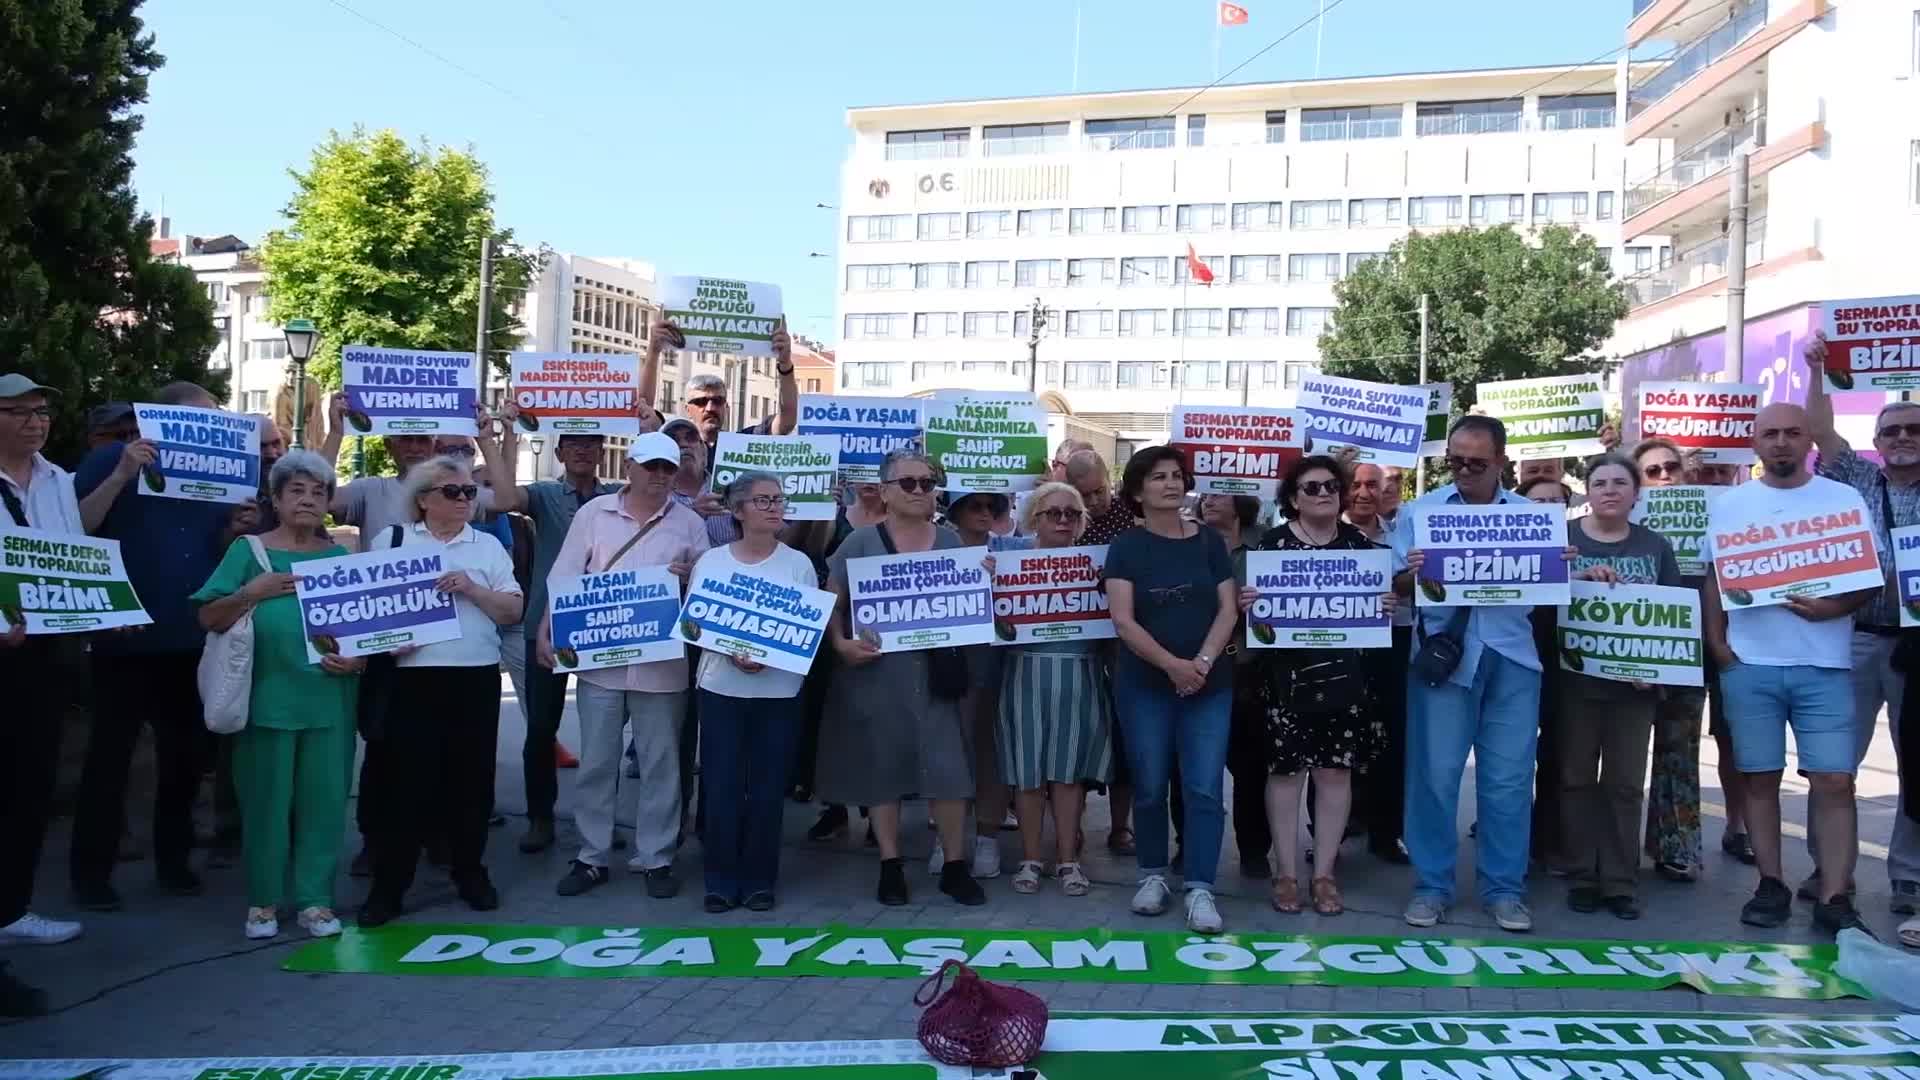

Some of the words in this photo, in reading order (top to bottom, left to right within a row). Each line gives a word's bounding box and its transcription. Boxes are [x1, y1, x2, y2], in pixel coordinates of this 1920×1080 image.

[696, 287, 748, 300] MADEN
[1834, 304, 1912, 321] SERMAYE
[1836, 322, 1859, 336] BU
[1862, 318, 1920, 333] TOPRA
[346, 352, 414, 366] ORMANIMI
[416, 356, 470, 368] SUYUMU
[1849, 338, 1920, 370] BİZİ
[363, 366, 458, 386] MADENE
[543, 359, 608, 372] ESKİŞEHİR
[520, 372, 568, 382] MADEN
[571, 371, 631, 384] ÇÖPLÜĞÜ
[359, 392, 459, 410] VERMEM!
[518, 389, 632, 410] OLMASIN!
[1303, 381, 1362, 399] HAVAMA
[1366, 390, 1424, 408] SUYUMA
[1482, 387, 1539, 402] HAVAMA
[1542, 382, 1599, 397] SUYUMA
[1645, 388, 1689, 406] DOĞA
[1693, 393, 1758, 411] YAŞAM
[955, 405, 1008, 420] YAŞAM
[1321, 396, 1403, 417] TOPRAĞIMA
[1503, 395, 1580, 411] TOPRAĞIMA
[140, 409, 208, 424] ORMANIMI
[211, 415, 256, 432] SUYUMU
[803, 402, 851, 421] DOĞA
[855, 408, 917, 427] YAŞAM
[1183, 413, 1249, 427] SERMAYE
[1251, 415, 1294, 428] DEFOL
[928, 417, 1037, 434] ALANLARIMIZA
[1184, 426, 1204, 439] BU
[1207, 427, 1292, 442] TOPRAKLAR
[160, 422, 247, 451] MADENE
[957, 437, 1004, 453] SAHİP
[747, 441, 812, 456] ESKİŞEHİR
[160, 449, 246, 478] VERMEM!
[723, 452, 770, 466] MADEN
[773, 453, 832, 469] ÇÖPLÜĞÜ
[940, 453, 1026, 470] ÇIKIYORUZ!
[1194, 446, 1279, 477] BİZİM!
[1649, 487, 1704, 500] ESKİŞEHİR
[1648, 500, 1706, 514] MADEN
[1428, 514, 1502, 529] SERMAYE
[1504, 513, 1553, 528] DEFOL
[1716, 522, 1777, 550] DOĞA
[1781, 509, 1862, 537] YAŞAM
[1430, 530, 1453, 543] BU
[1455, 528, 1552, 543] TOPRAKLAR
[4, 536, 68, 557] SERMAYE
[71, 545, 110, 561] DEFOL
[5, 553, 25, 567] BU
[29, 556, 111, 575] TOPRAKLAR
[881, 556, 956, 577] ESKİŞEHİR
[1020, 553, 1092, 572] ESKİŞEHİR
[1281, 556, 1358, 575] ESKİŞEHİR
[1443, 549, 1541, 582] BİZİM!
[1722, 539, 1864, 580] ÖZGÜRLÜK!
[303, 565, 363, 591] DOĞA
[367, 555, 442, 582] YAŞAM
[582, 571, 636, 591] YAŞAM
[858, 577, 912, 594] MADEN
[914, 568, 982, 592] ÇÖPLÜĞÜ
[996, 572, 1048, 586] MADEN
[1256, 574, 1311, 588] MADEN
[1313, 570, 1384, 590] ÇÖPLÜĞÜ
[18, 578, 113, 610] BİZİM!
[730, 572, 802, 600] ESKİŞEHİR
[308, 587, 450, 627] ÖZGÜRLÜK!
[555, 584, 669, 610] ALANLARIMIZA
[702, 578, 753, 602] MADEN
[752, 594, 823, 622] ÇÖPLÜĞÜ
[994, 590, 1109, 617] OLMASIN
[586, 605, 634, 627] SAHİP
[857, 592, 985, 624] OLMASIN!
[1252, 596, 1383, 620] OLMASIN!
[1568, 595, 1692, 629] KÖYÜME
[568, 621, 659, 650] ÇIKIYORUZ!
[688, 600, 816, 650] OLMASIN!
[1564, 631, 1696, 663] DOKUNMA!
[401, 927, 715, 967] DOĞA
[755, 933, 1148, 975] YAŞAM
[1175, 936, 1822, 988] ÖZGÜRLÜK!
